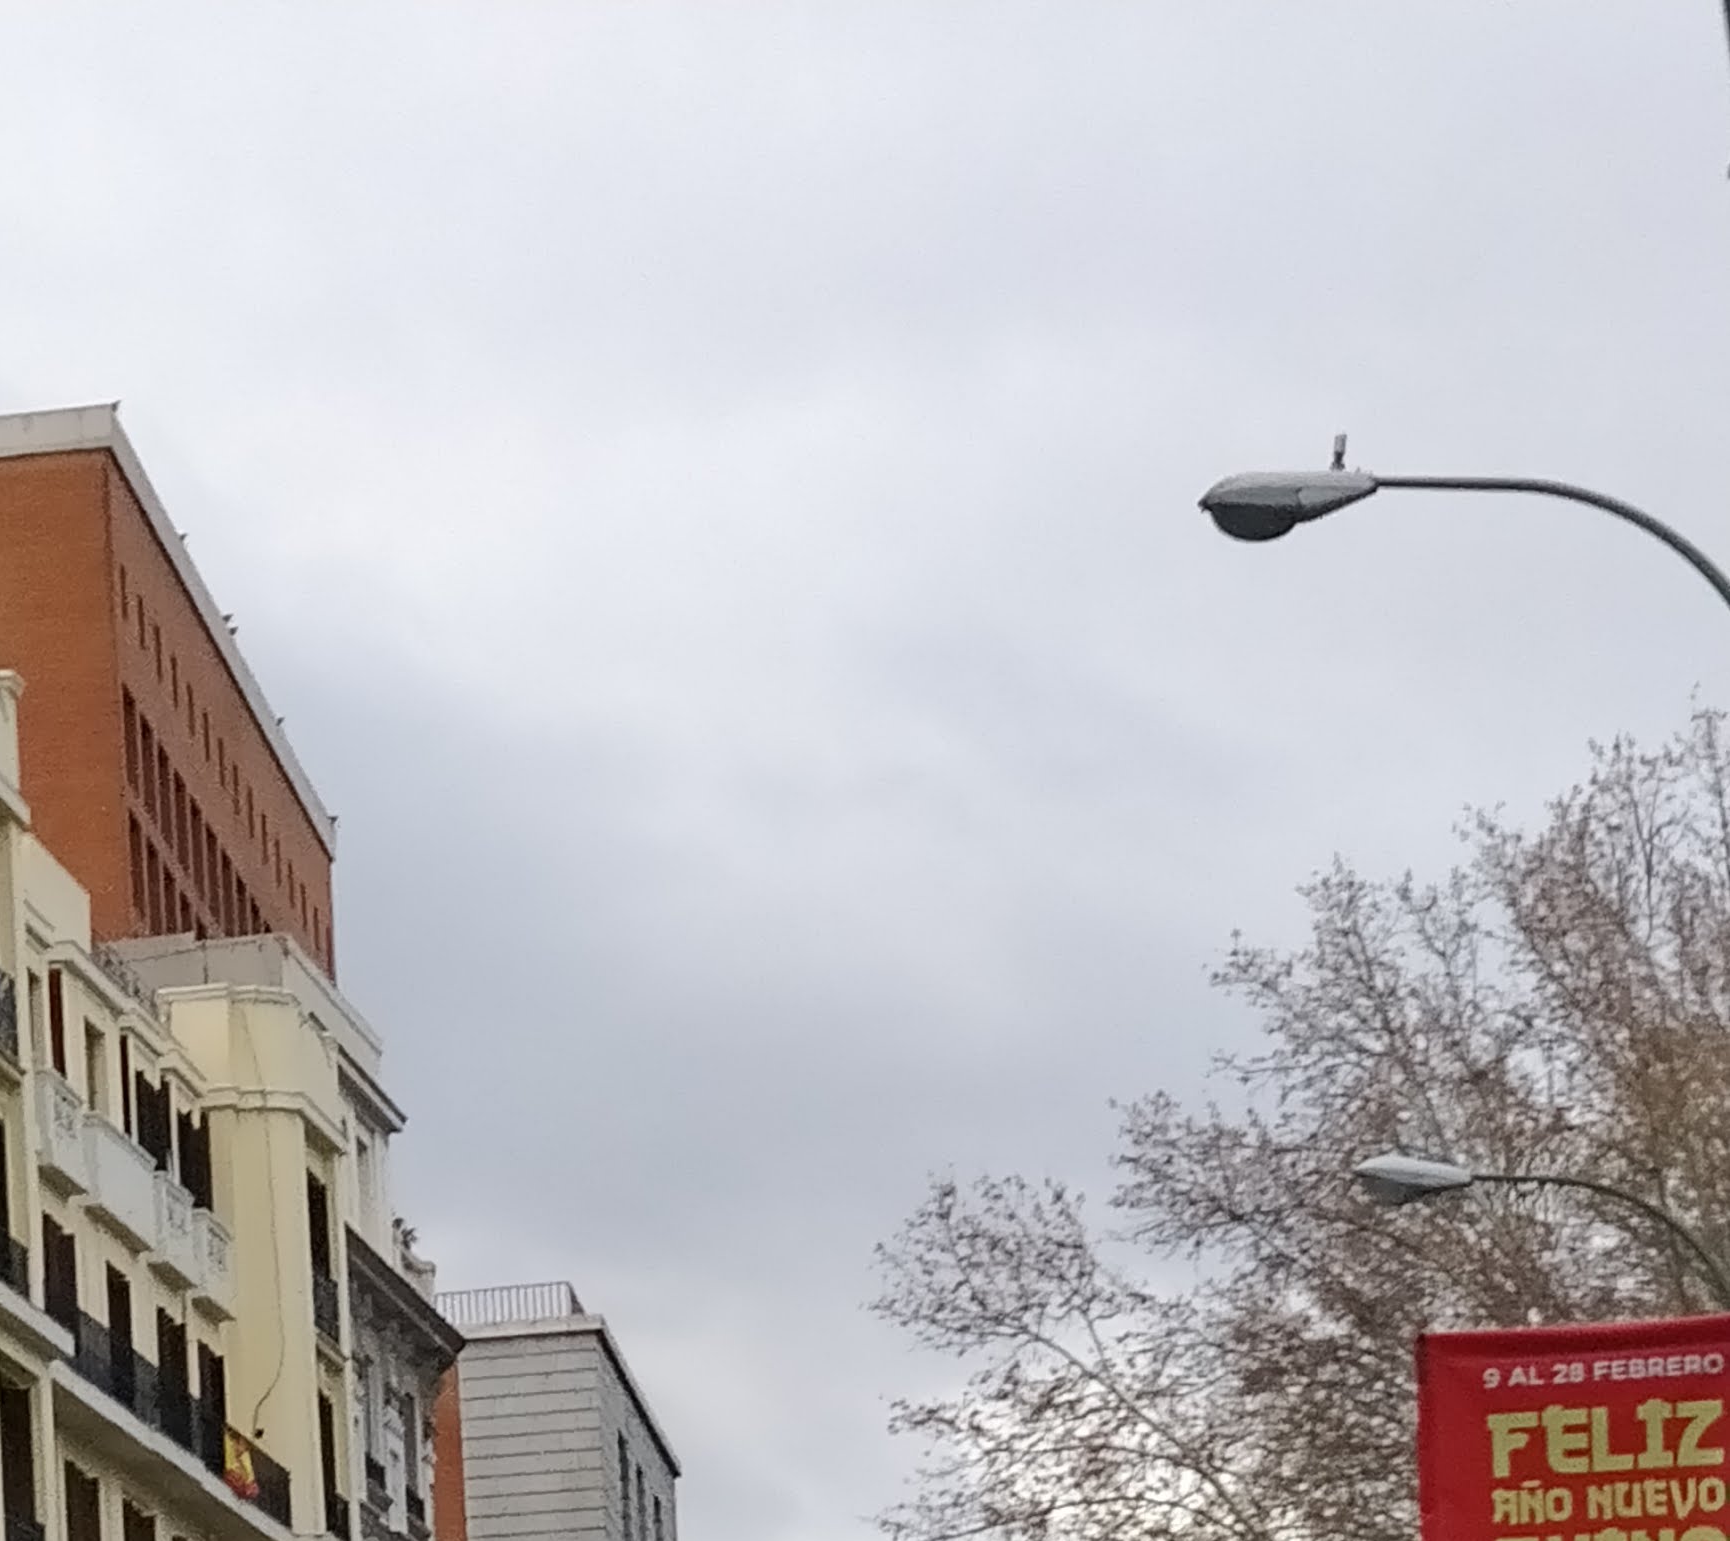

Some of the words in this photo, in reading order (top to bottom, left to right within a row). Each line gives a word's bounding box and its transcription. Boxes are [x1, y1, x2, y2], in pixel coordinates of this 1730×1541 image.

[1483, 1367, 1501, 1389] 9
[1508, 1366, 1544, 1387] AL
[1553, 1362, 1585, 1384] 28
[1593, 1353, 1725, 1381] FEBRERO
[1486, 1397, 1725, 1479] FELIZ
[1491, 1479, 1573, 1526] AÑO
[1586, 1476, 1727, 1520] NUEVO
